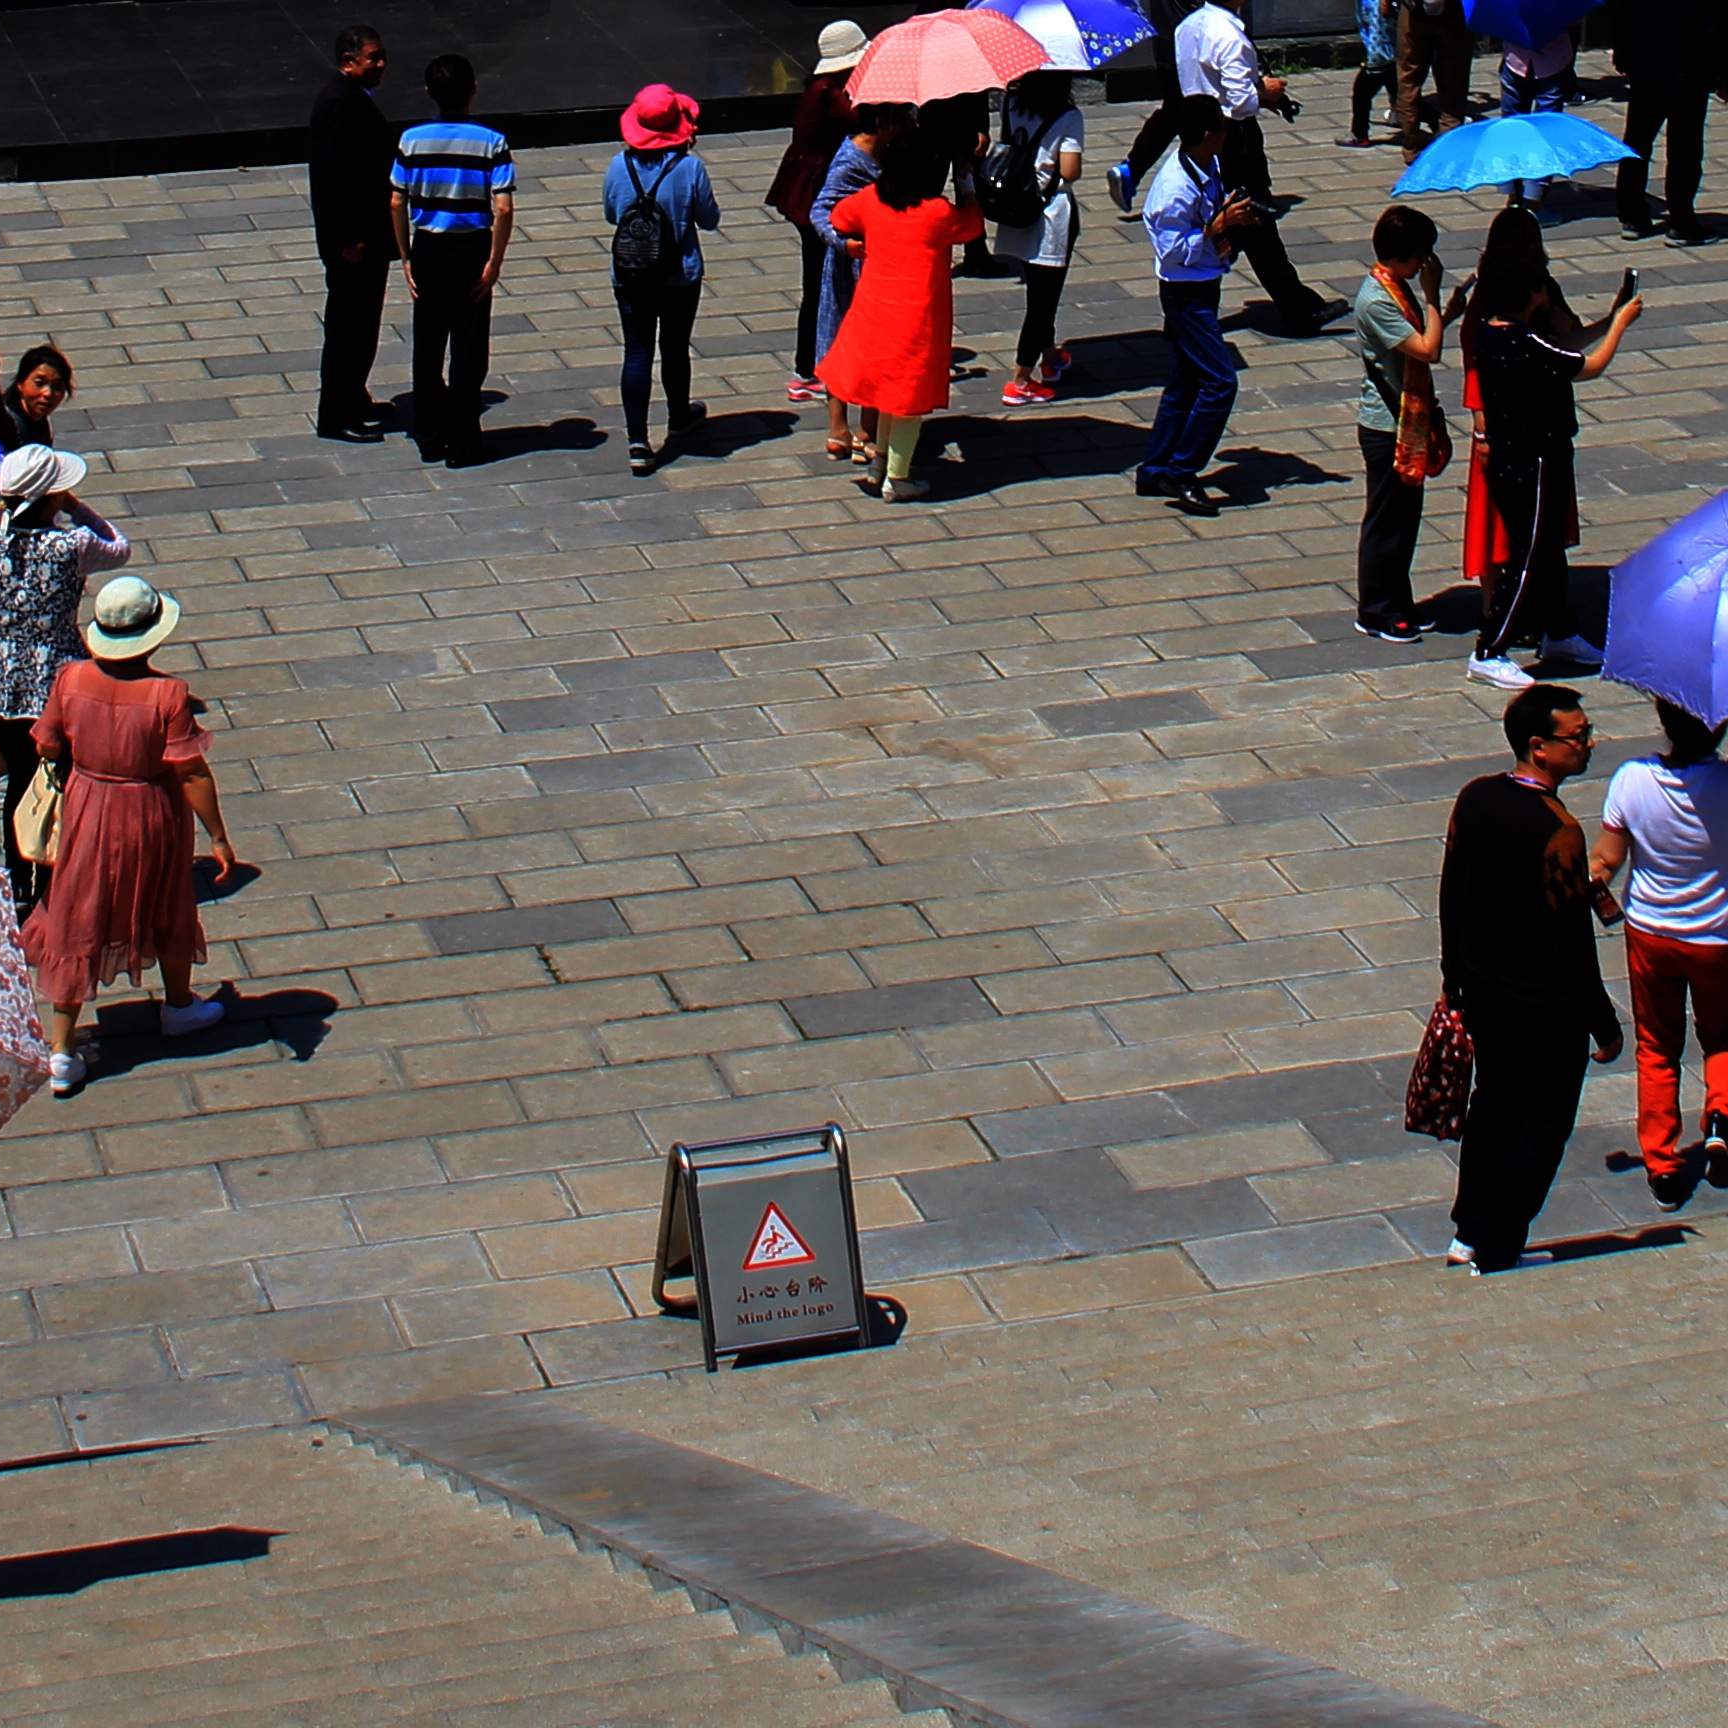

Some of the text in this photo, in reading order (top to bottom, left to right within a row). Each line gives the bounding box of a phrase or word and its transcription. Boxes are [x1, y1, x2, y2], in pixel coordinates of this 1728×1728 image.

[737, 1275, 828, 1303] 小心台阶
[737, 1303, 834, 1326] Mind the logo
